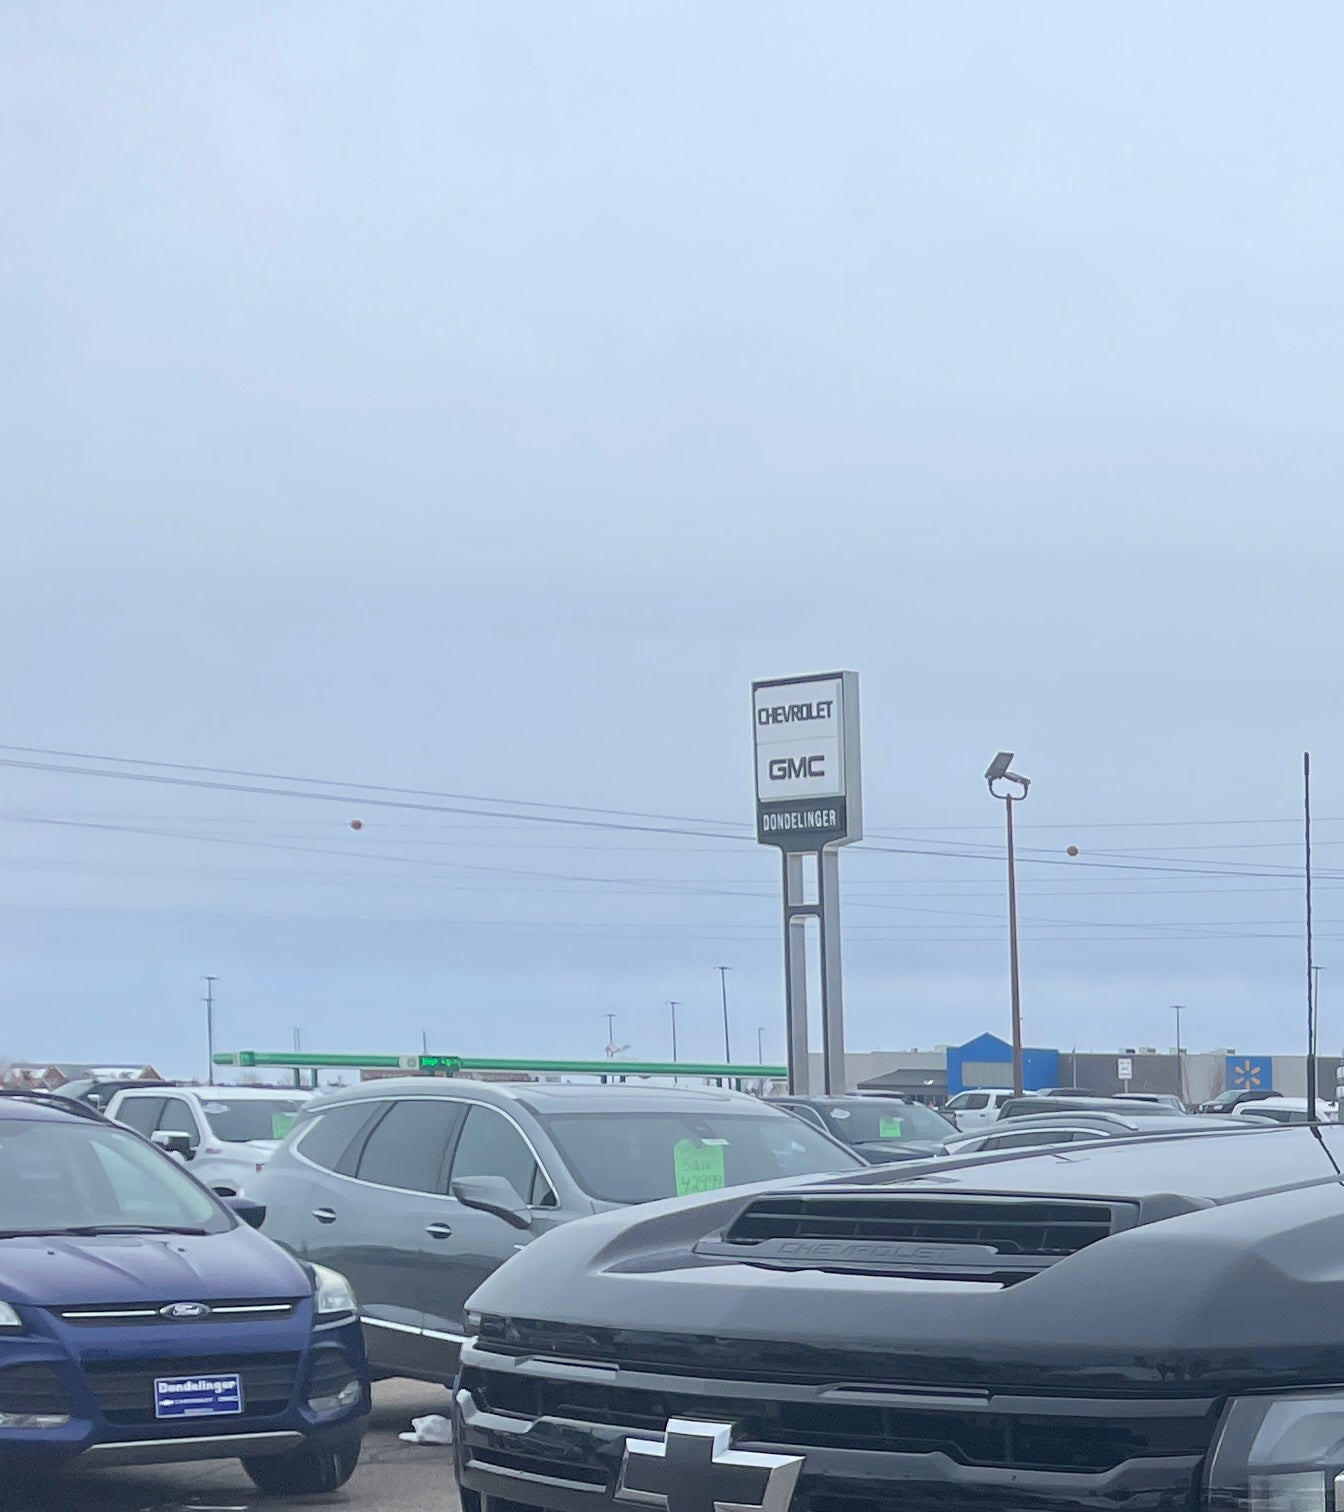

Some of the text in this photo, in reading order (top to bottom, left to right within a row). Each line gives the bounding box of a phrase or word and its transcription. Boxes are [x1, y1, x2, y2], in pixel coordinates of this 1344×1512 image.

[758, 700, 833, 726] CHEVROLET
[768, 755, 825, 781] GMC
[763, 809, 837, 831] DONDELINGER
